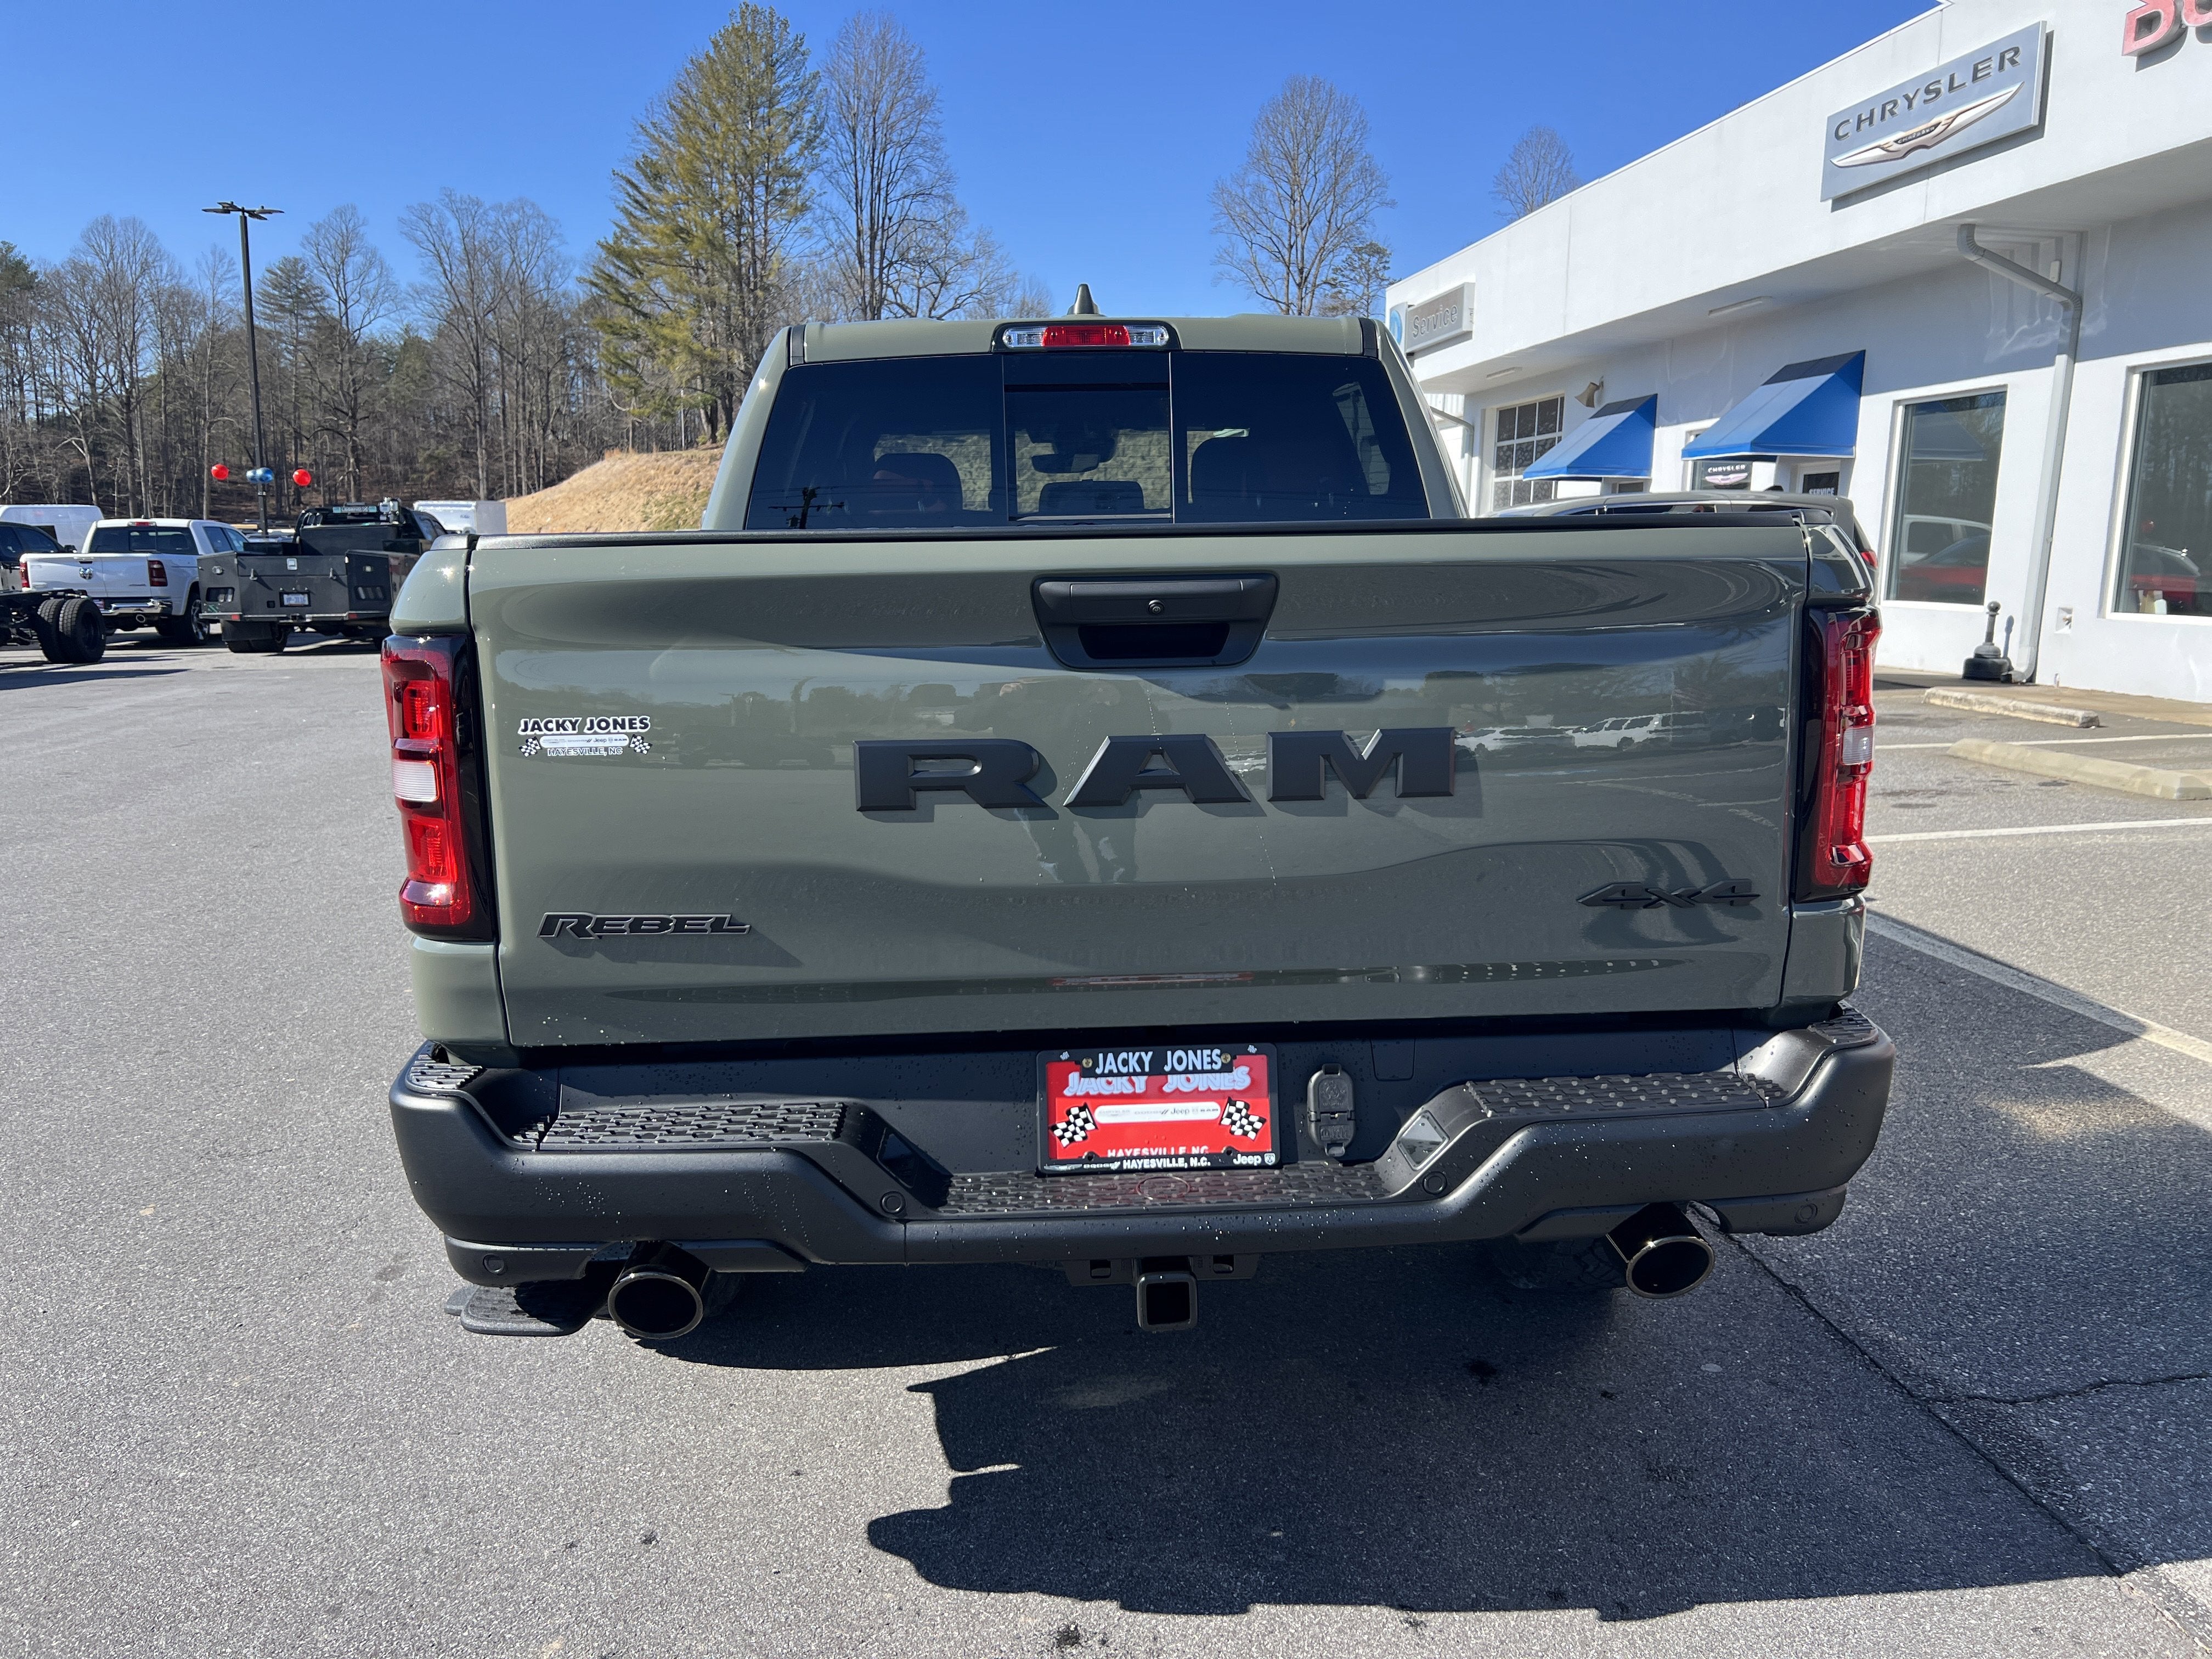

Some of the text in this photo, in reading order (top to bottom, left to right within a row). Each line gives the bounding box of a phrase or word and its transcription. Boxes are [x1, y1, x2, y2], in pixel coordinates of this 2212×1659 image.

[1835, 46, 2021, 141] CHRYSLER
[1412, 304, 1458, 339] Service
[1707, 464, 1747, 473] CHRYSLER
[1808, 487, 1835, 496] SERVICE
[518, 716, 651, 735] JACKY JONES
[548, 747, 623, 757] HAYESVILLE, NC
[852, 726, 1455, 812] RAM
[536, 911, 752, 940] REBEL
[1095, 1048, 1222, 1075] JACKY JONES
[1063, 1065, 1252, 1097] JACKY JONES
[1170, 1106, 1190, 1115] Jeep
[1122, 1156, 1211, 1169] HAYESVILLE, N.C.
[1233, 1153, 1262, 1165] Jeep
